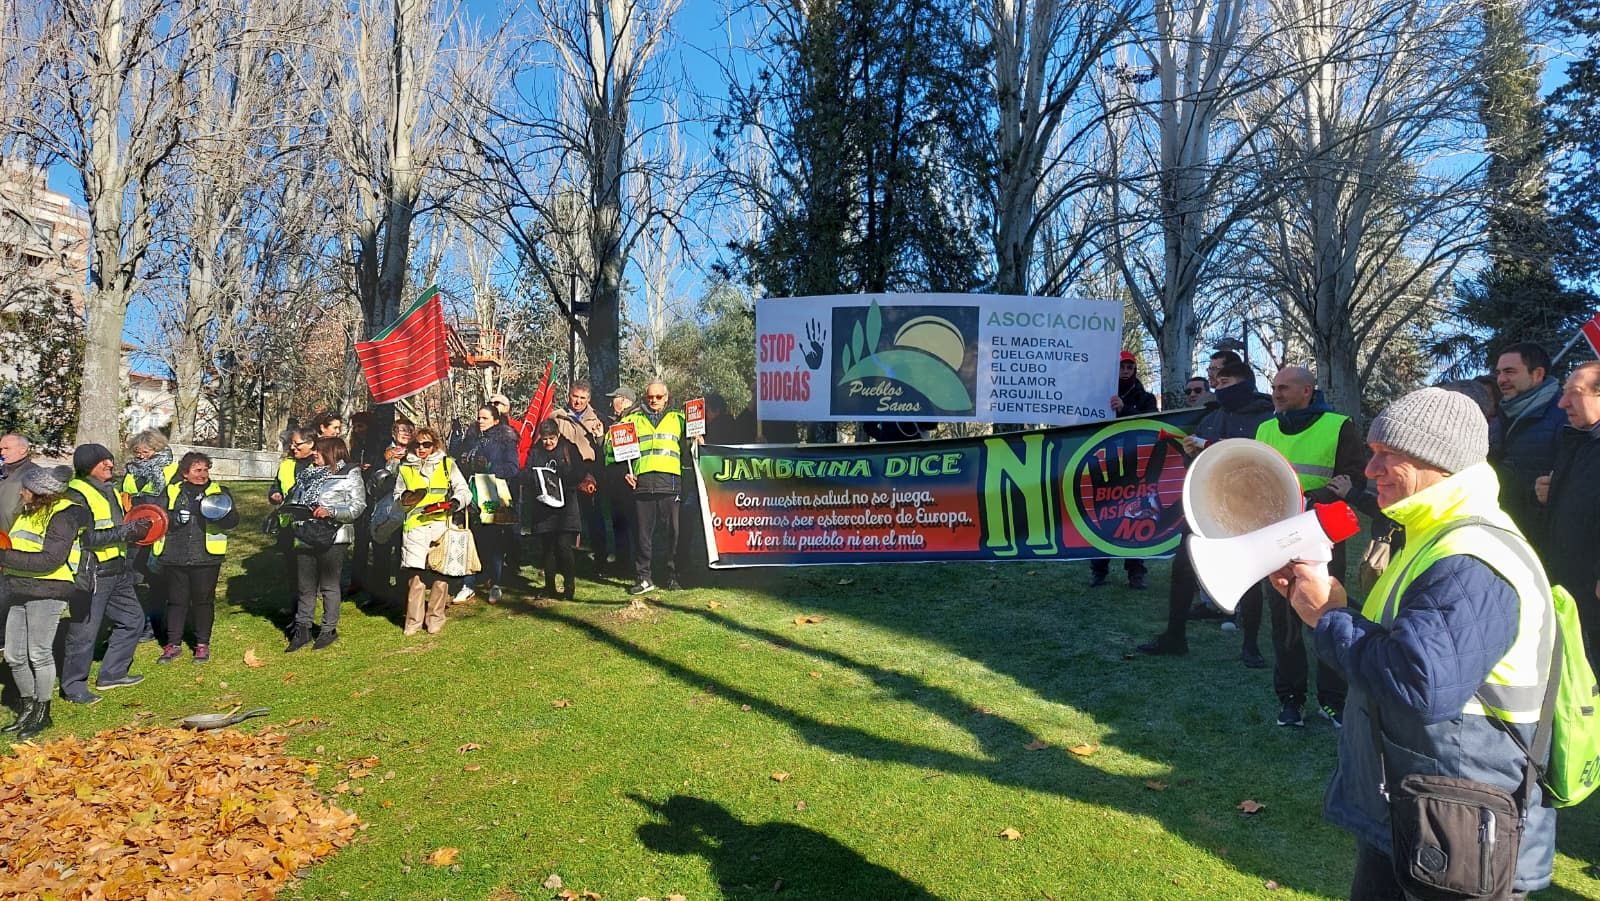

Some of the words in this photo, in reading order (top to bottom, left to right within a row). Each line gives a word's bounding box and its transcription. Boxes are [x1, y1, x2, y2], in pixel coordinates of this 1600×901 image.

[987, 312, 1116, 332] ASOCIACIÓN
[760, 333, 795, 363] STOP
[992, 336, 1007, 346] EL
[1011, 337, 1073, 348] MADERAL
[991, 350, 1089, 362] CUELGAMURES
[991, 363, 1006, 372] EL
[1010, 363, 1047, 373] CUBO
[760, 365, 810, 402] BIOGÁS
[848, 380, 904, 397] Pueblos
[991, 376, 1056, 387] VILLAMOR
[990, 389, 1063, 400] ARGUJILLO
[876, 396, 921, 412] Sanos
[990, 402, 1106, 419] FUENTESPREADAS
[715, 457, 872, 480] JAMBRINA
[885, 453, 962, 477] DICE
[735, 492, 761, 507] Con
[762, 490, 812, 507] nuestra
[812, 489, 851, 507] salud
[852, 493, 869, 505] no
[871, 492, 889, 505] se
[1096, 479, 1158, 502] BIOGÁS
[725, 515, 789, 532] queremos
[791, 516, 815, 527] ser
[817, 509, 892, 526] estercolero
[896, 508, 914, 523] de
[1114, 517, 1156, 542] NO
[746, 530, 762, 547] Ni
[764, 536, 782, 546] en
[783, 531, 797, 545] tu
[798, 530, 844, 551] pueblo
[847, 530, 861, 546] ni
[863, 535, 880, 546] en
[882, 530, 897, 545] el
[898, 529, 924, 545] mío
